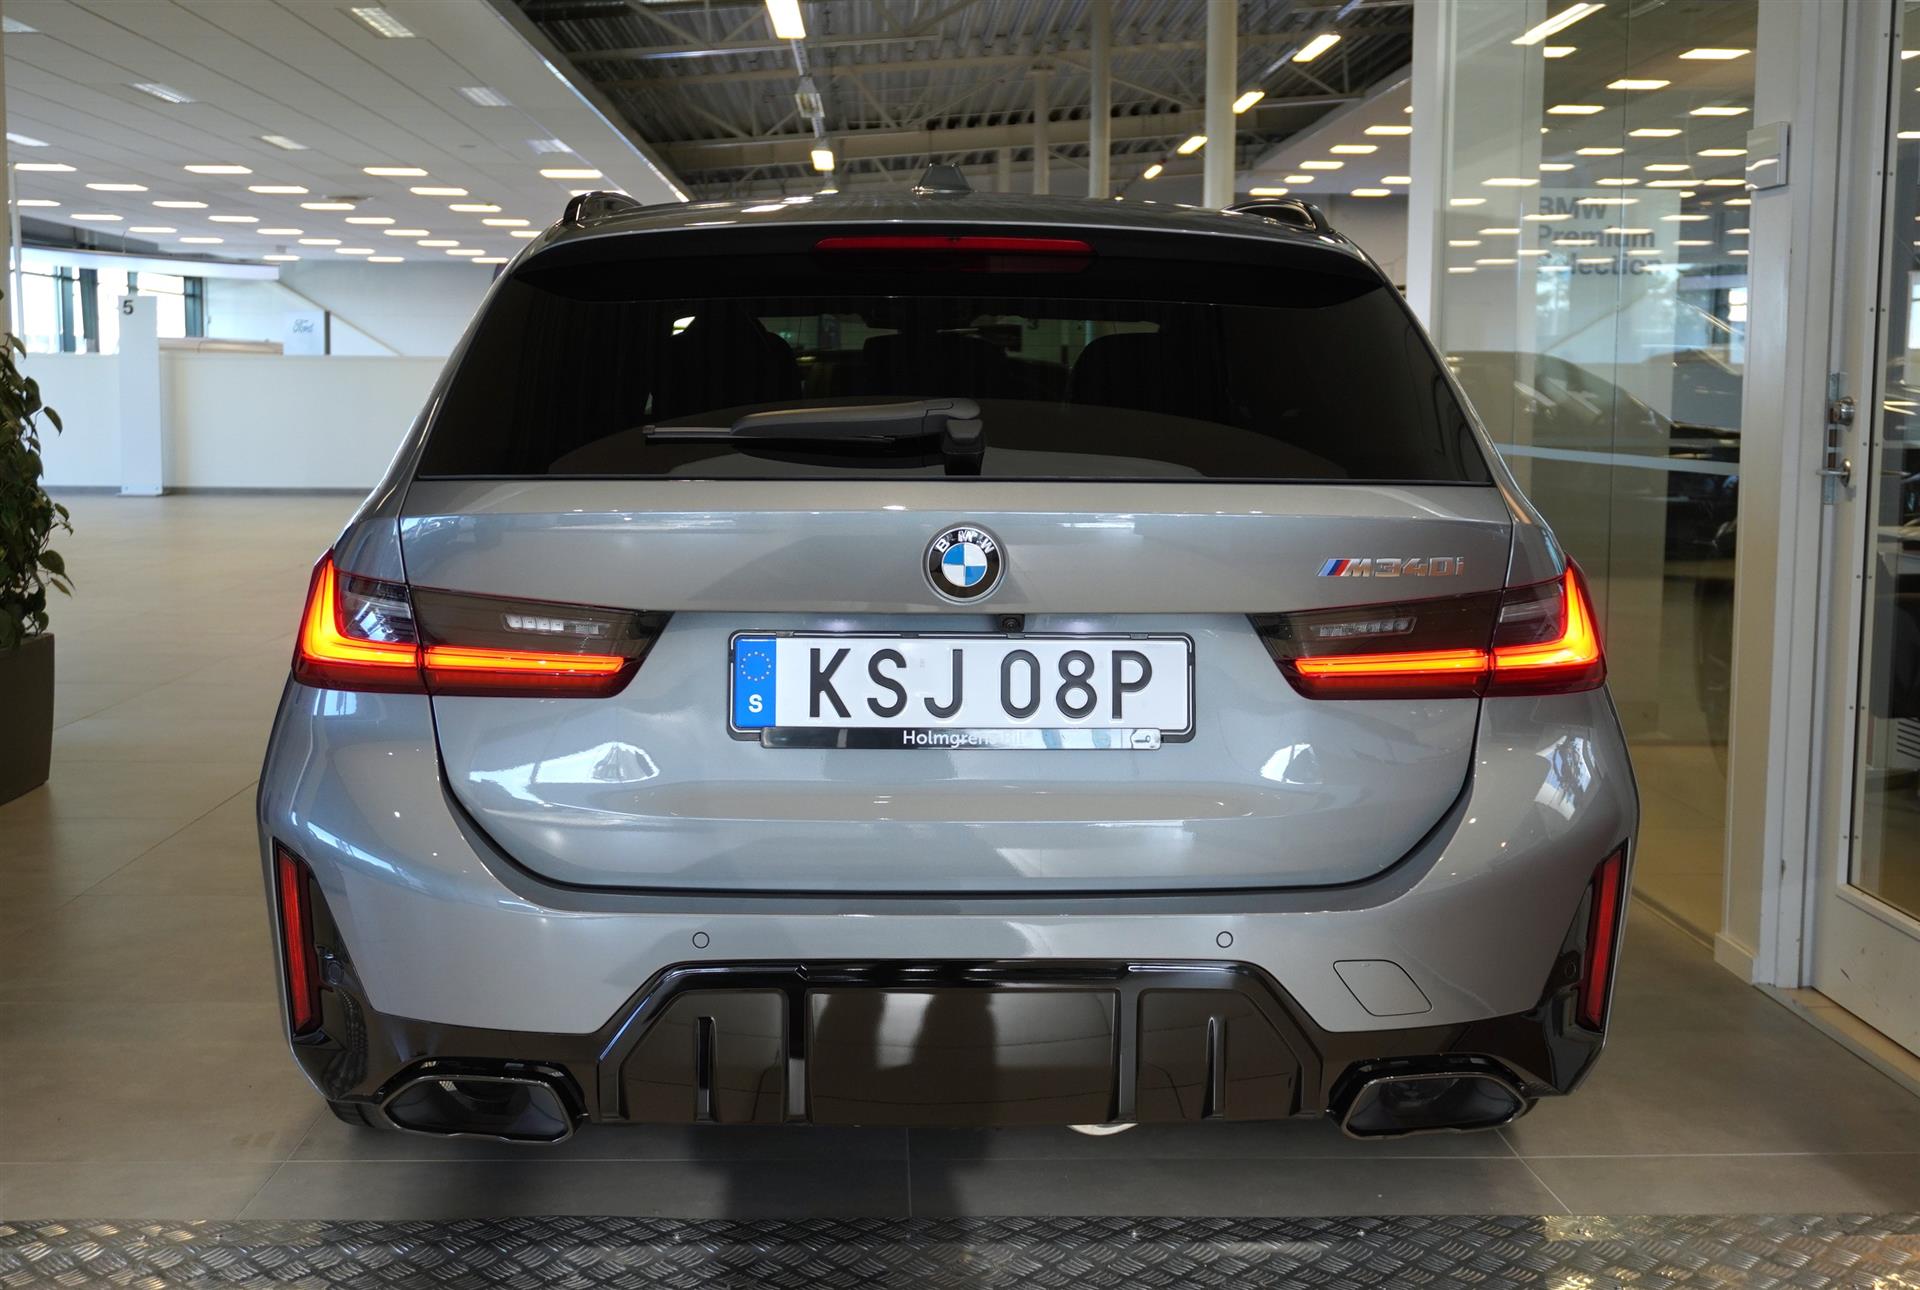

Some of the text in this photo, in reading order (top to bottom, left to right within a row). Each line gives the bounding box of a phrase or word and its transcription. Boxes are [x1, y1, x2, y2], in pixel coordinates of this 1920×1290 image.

[123, 299, 134, 316] 5
[935, 529, 995, 554] BMW
[1340, 556, 1465, 578] M340i
[808, 647, 1153, 720] KSJ 08P
[748, 694, 763, 713] S
